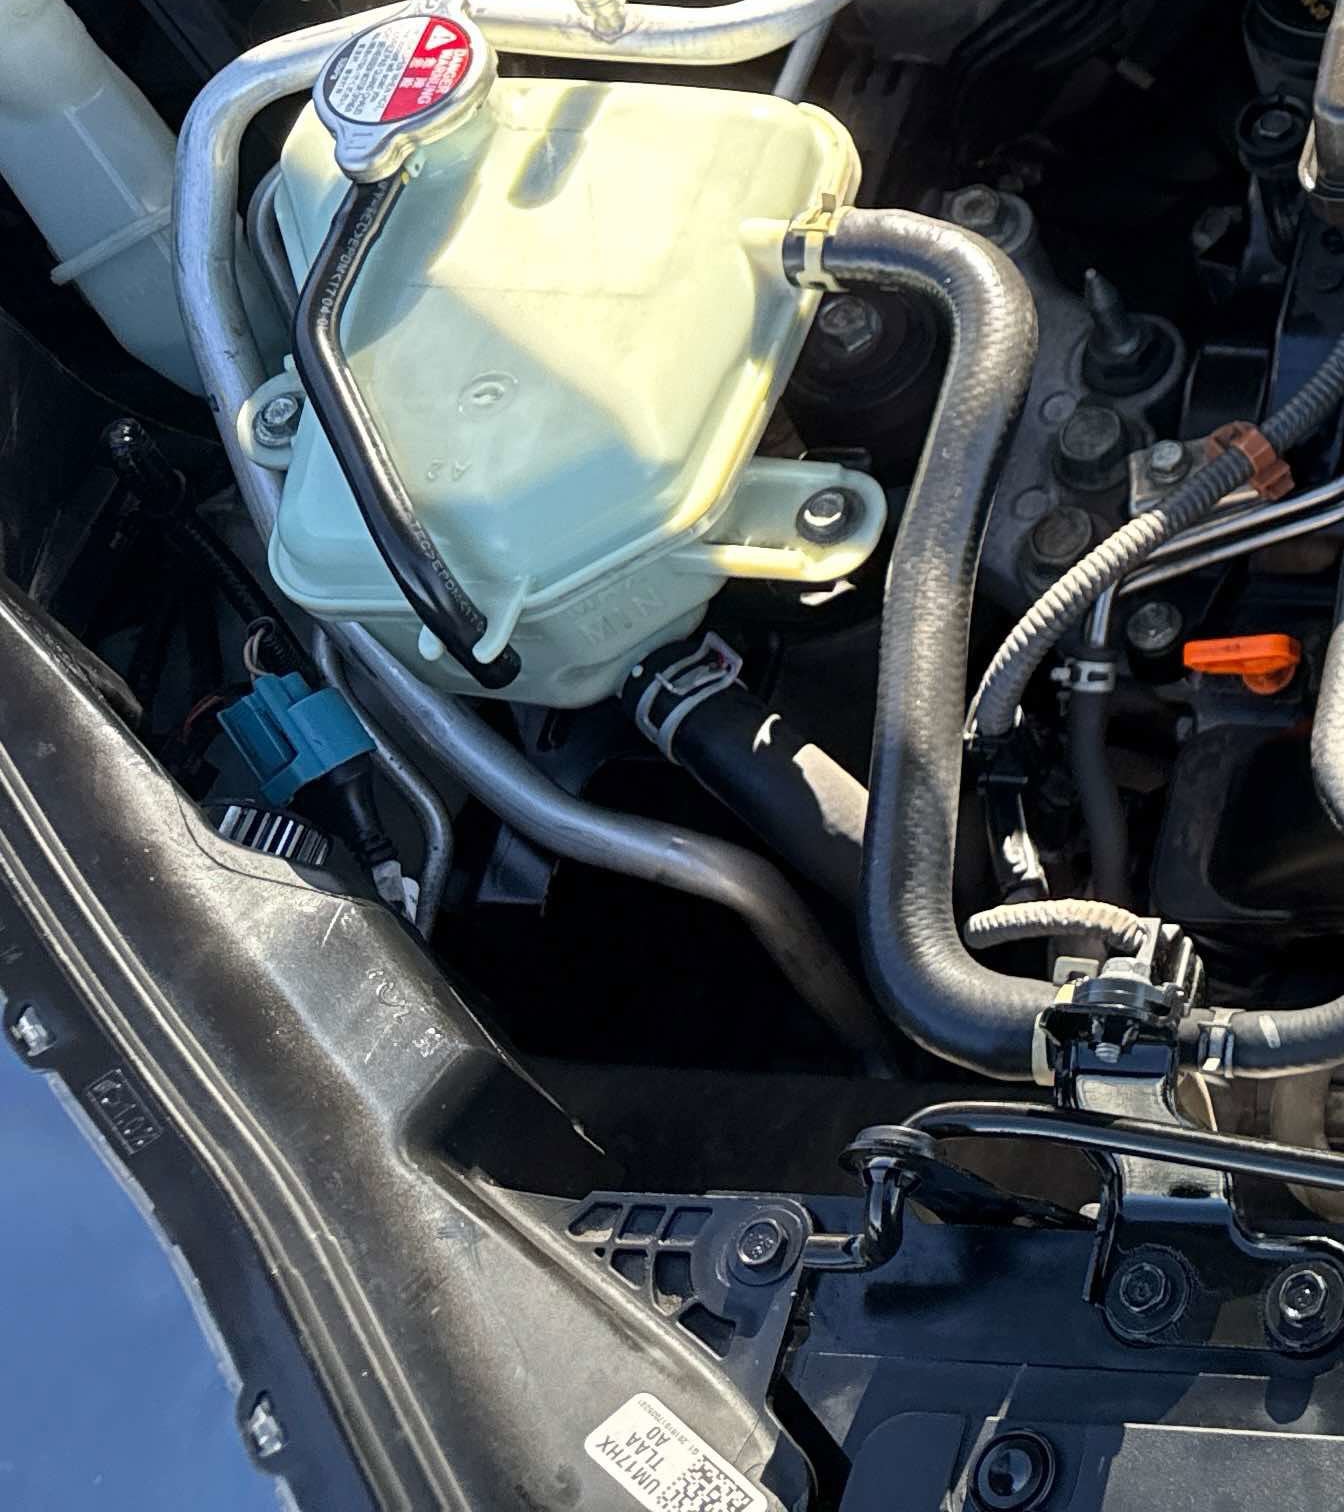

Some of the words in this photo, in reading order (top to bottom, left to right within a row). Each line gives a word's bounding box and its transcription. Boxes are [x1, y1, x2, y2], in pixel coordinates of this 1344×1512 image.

[416, 49, 454, 105] WARNING
[438, 48, 468, 95] DANGER
[595, 1434, 661, 1496] UM17HX
[625, 1431, 664, 1472] TLAA
